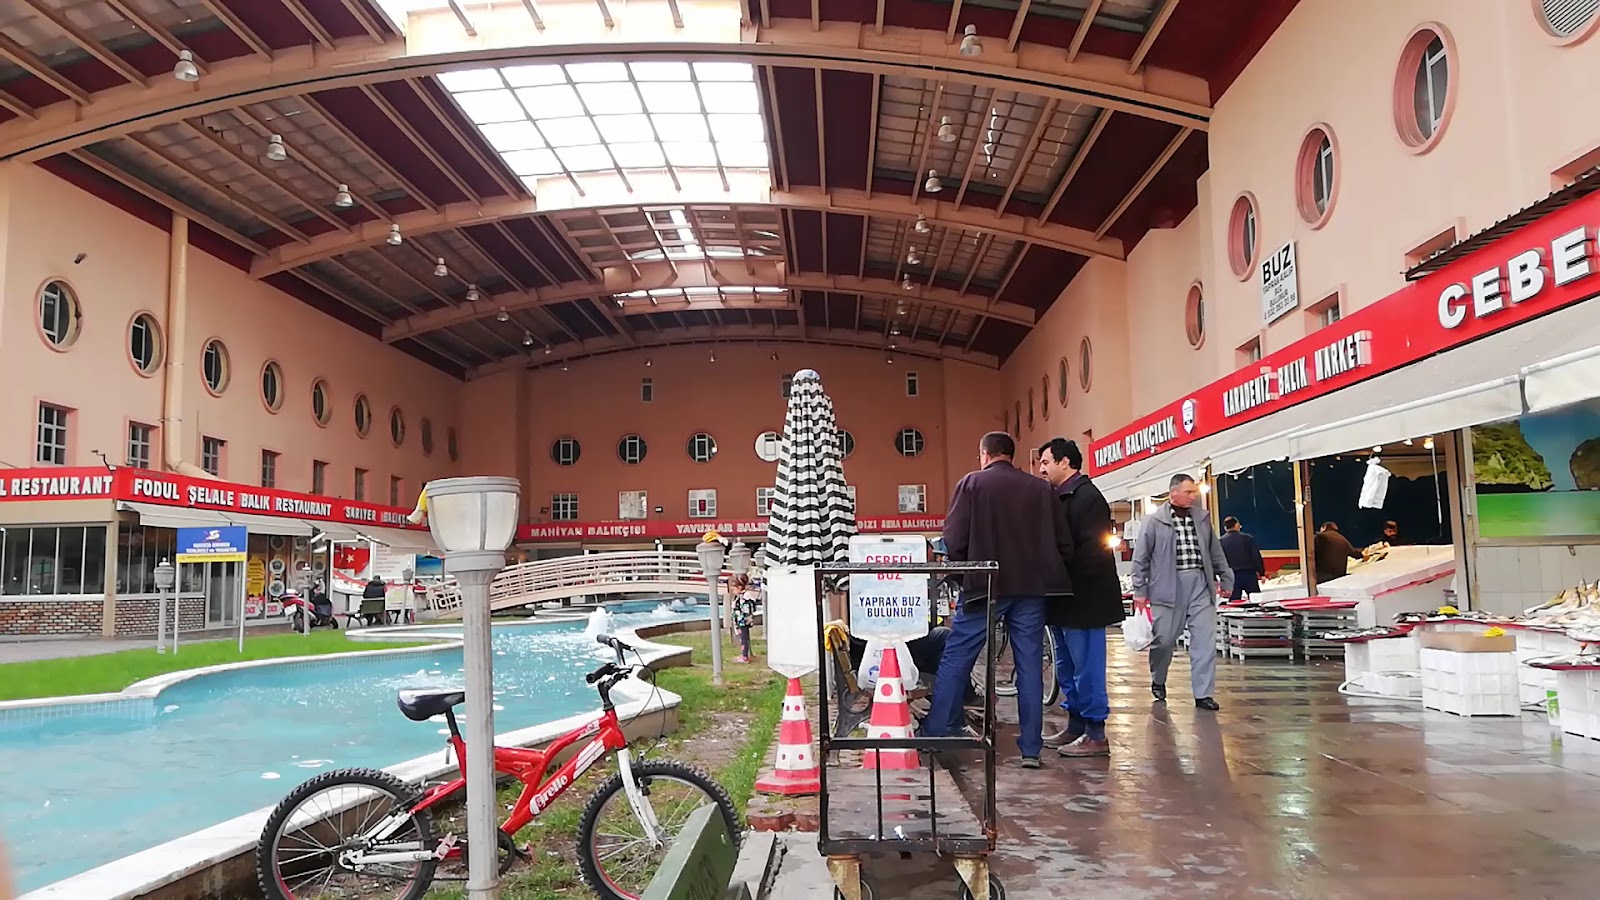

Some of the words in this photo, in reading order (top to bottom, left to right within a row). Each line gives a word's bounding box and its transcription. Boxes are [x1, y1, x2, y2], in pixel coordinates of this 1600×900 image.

[1262, 243, 1291, 285] BUZ
[1438, 225, 1600, 329] CEBE
[1277, 356, 1308, 396] BALIK
[1314, 330, 1366, 381] MARKET
[1094, 440, 1122, 468] YAPRAK
[1124, 415, 1175, 456] BALIKÇILIK
[11, 475, 113, 496] RESTAURANT
[133, 478, 180, 500] FODUL
[188, 485, 235, 505] ŞELALE
[240, 492, 270, 511] BALIK
[275, 497, 332, 517] RESTAURANT
[345, 506, 376, 521] SARIYER
[530, 526, 583, 537] MAHİYAN
[587, 525, 646, 537] BALIKÇISI
[676, 523, 733, 534] YAVUZLAR
[877, 572, 902, 581] BUZ
[859, 596, 898, 607] YAPRAK
[902, 596, 921, 607] BUZ
[867, 607, 914, 618] BULUNUR
